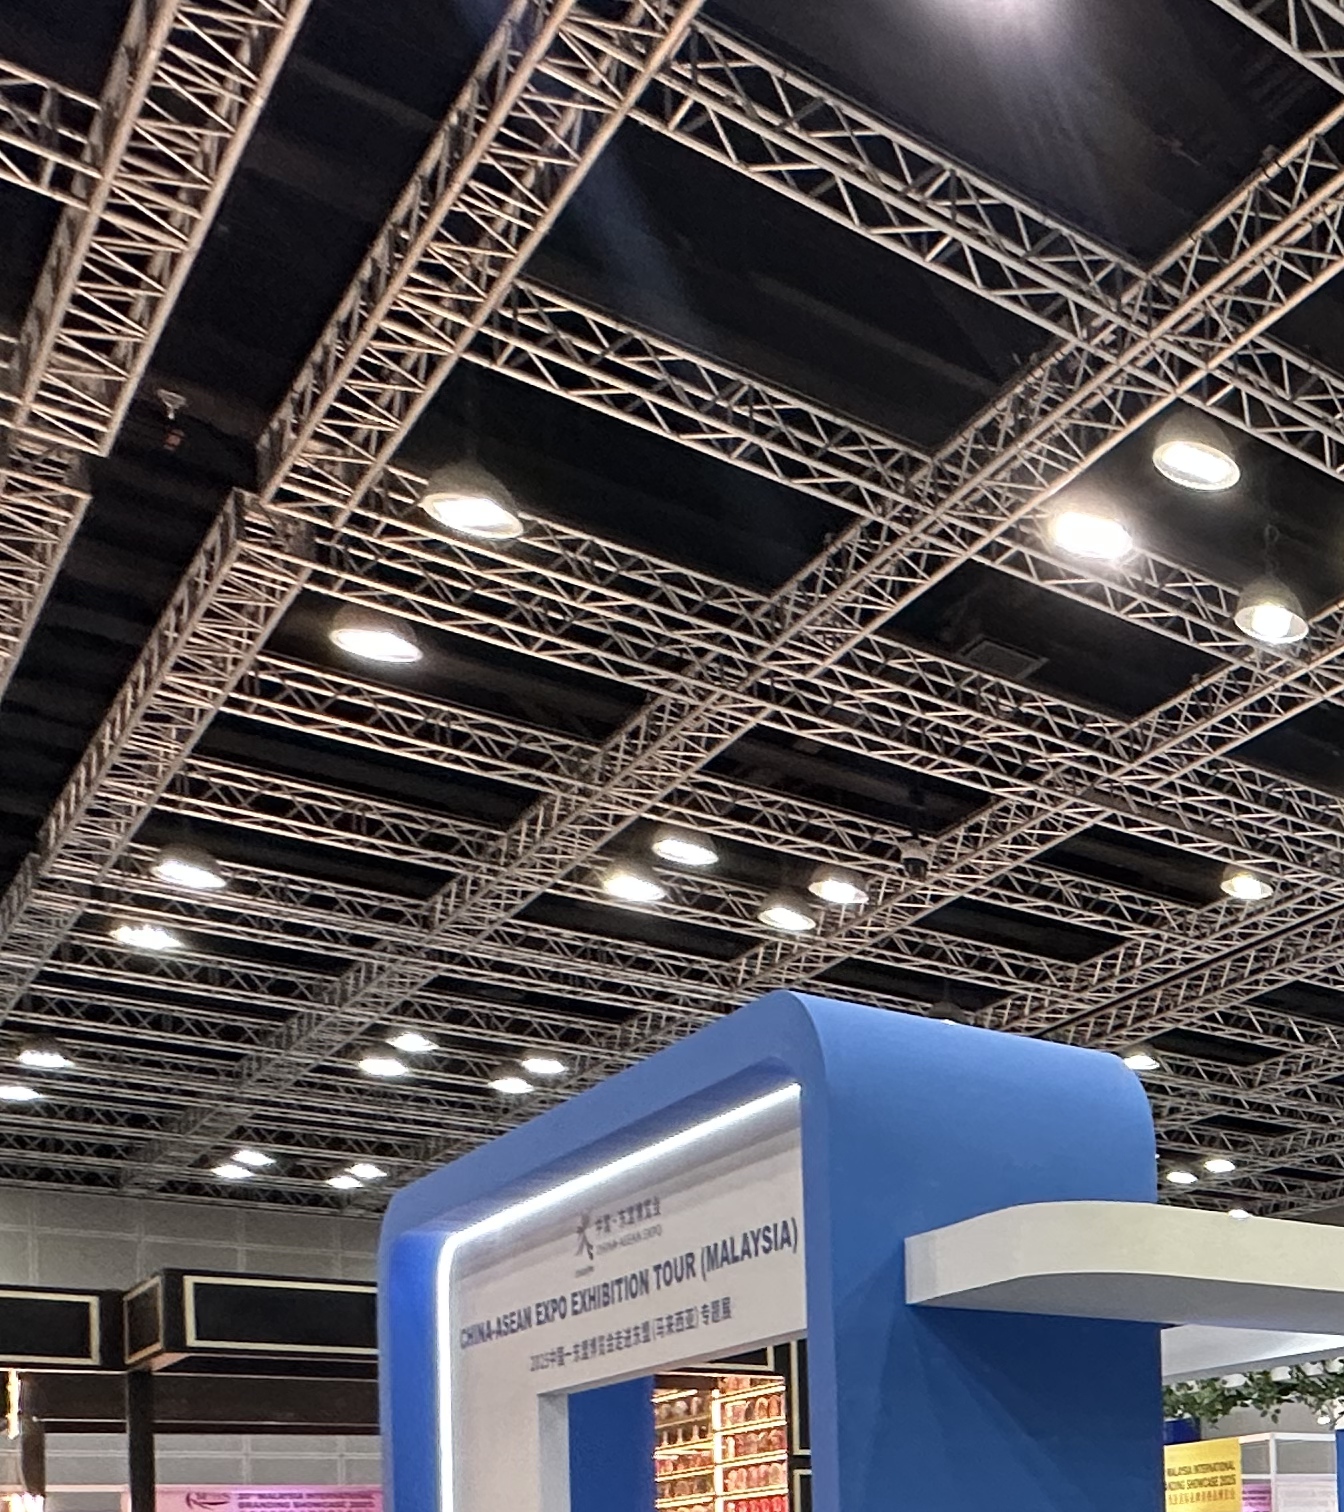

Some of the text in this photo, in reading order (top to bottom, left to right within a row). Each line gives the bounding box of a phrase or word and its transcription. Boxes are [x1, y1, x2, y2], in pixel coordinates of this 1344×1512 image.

[460, 1217, 798, 1349] CHINA-ASEAN EXPO EXHIBITION TOUR (MALAYSIA)
